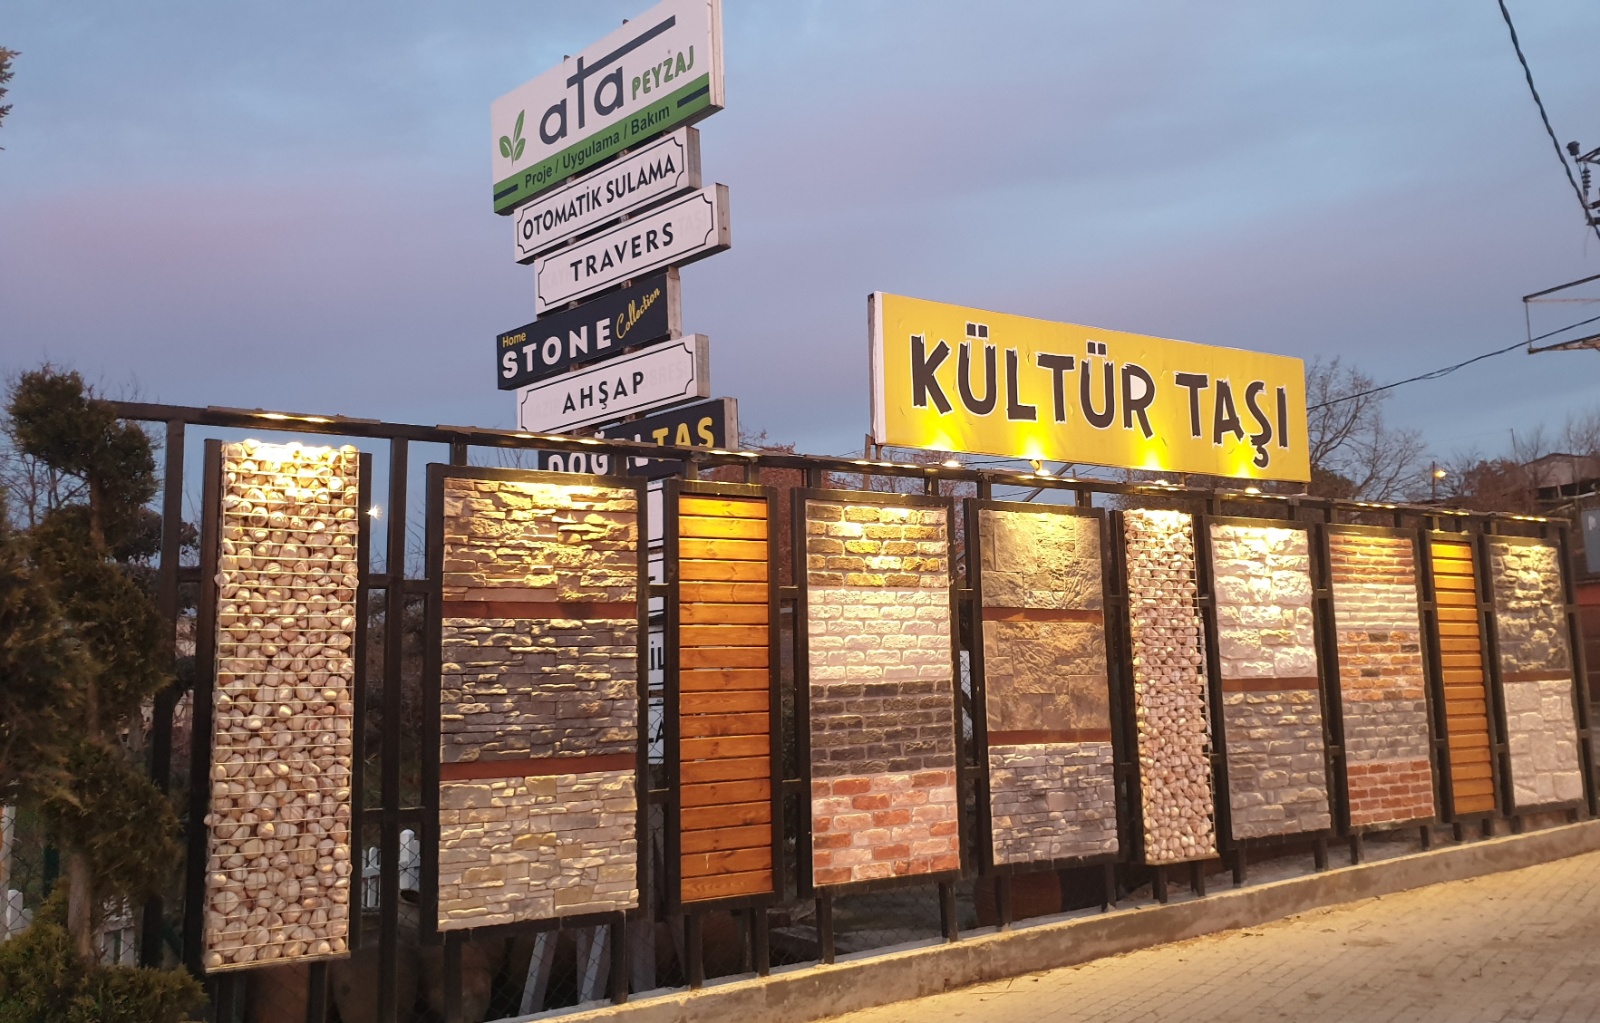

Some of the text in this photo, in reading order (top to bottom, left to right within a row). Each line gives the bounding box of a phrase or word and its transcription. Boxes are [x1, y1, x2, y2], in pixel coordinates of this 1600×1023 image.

[632, 45, 694, 100] PEYZAJ
[525, 165, 552, 188] Proje
[562, 132, 620, 170] Uygulama
[631, 106, 670, 135] Bakım
[523, 153, 676, 240] OTOMATİK SULAMA
[570, 222, 674, 282] TRAVERS
[502, 331, 527, 348] Home
[616, 287, 660, 339] Collection
[502, 318, 612, 379] STONE
[561, 371, 644, 415] AHŞAP
[911, 322, 1289, 468] KÜLTÜR TAŞI
